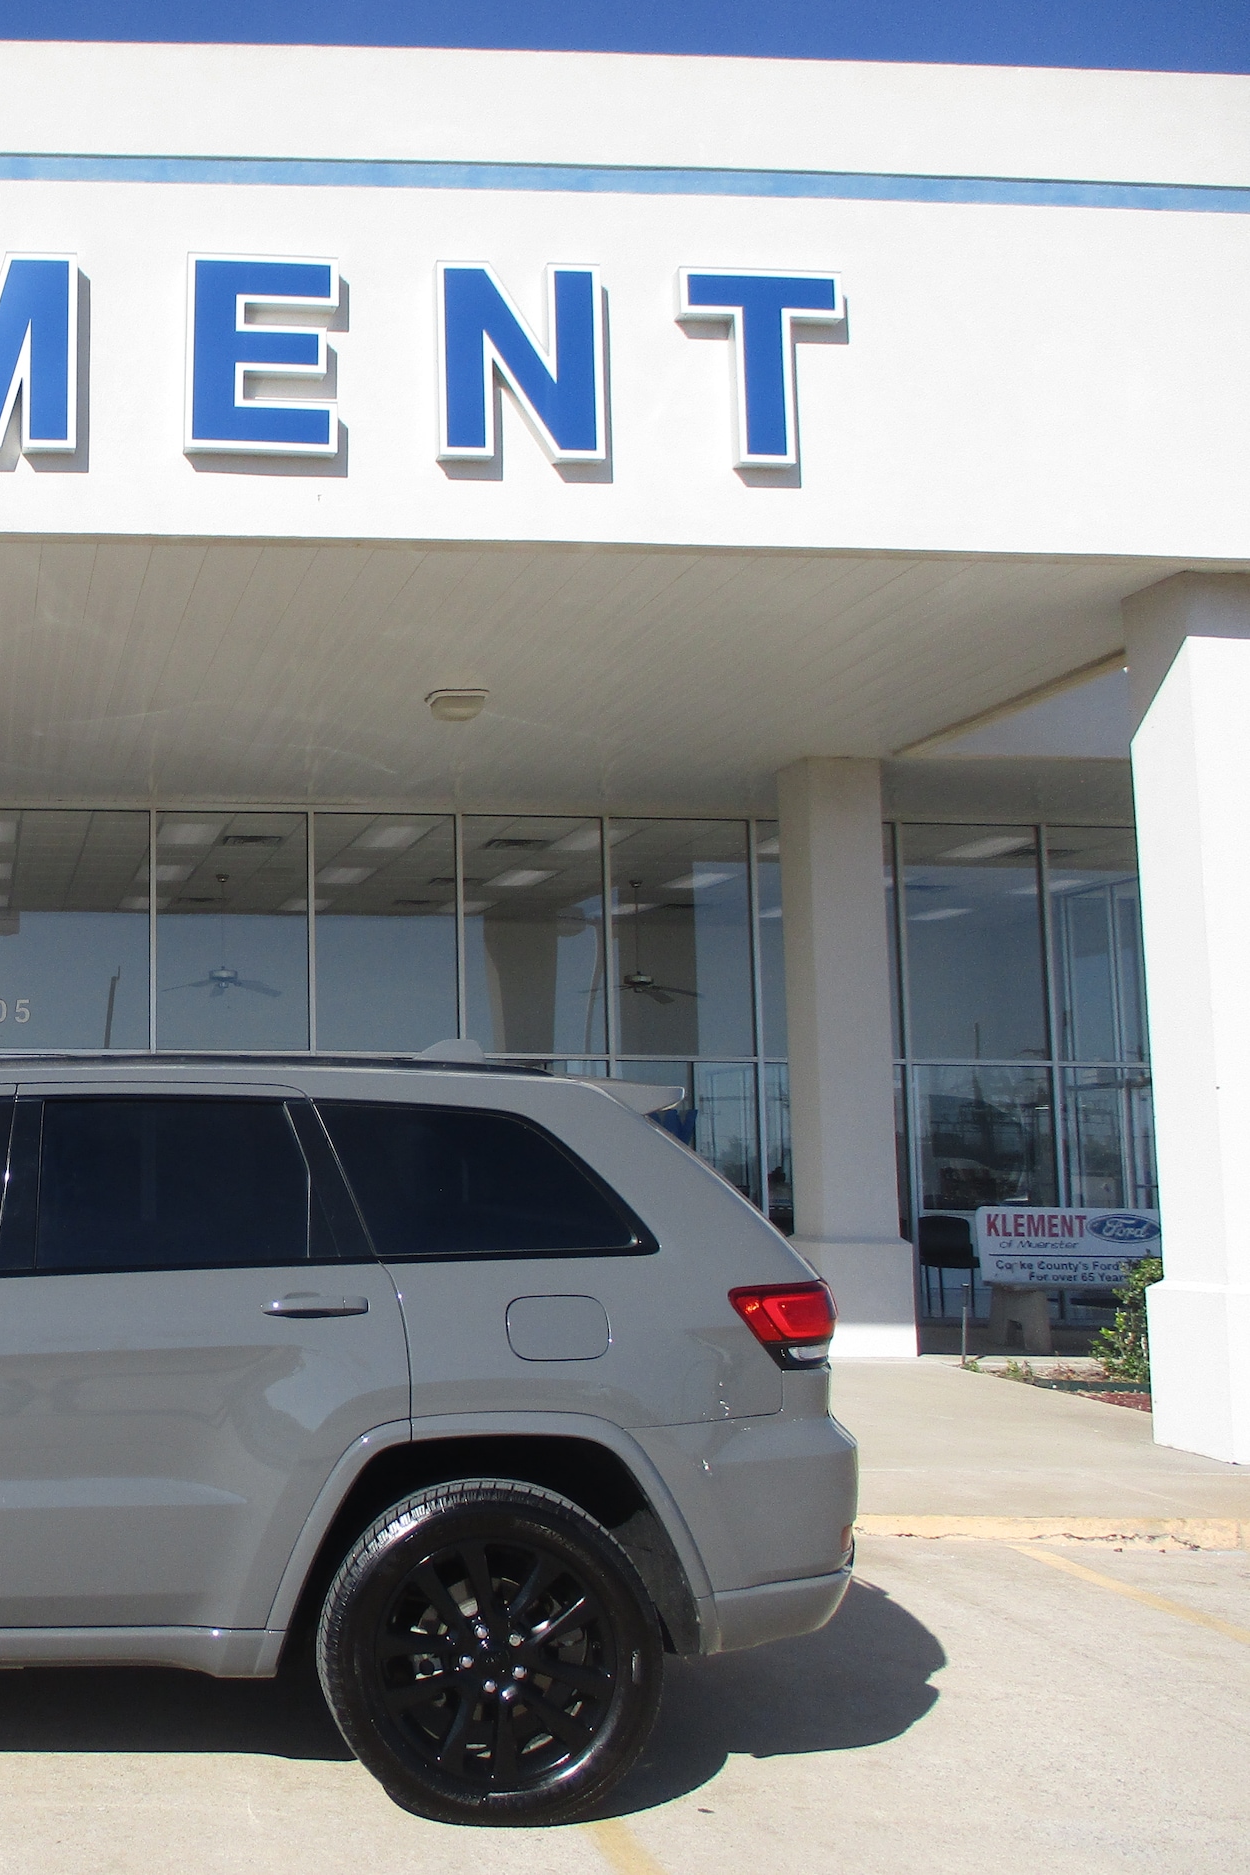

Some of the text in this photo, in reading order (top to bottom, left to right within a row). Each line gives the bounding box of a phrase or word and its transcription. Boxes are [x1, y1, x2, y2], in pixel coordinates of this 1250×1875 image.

[986, 1213, 1088, 1238] KLEMENT
[1103, 1217, 1151, 1238] Ford
[999, 1239, 1080, 1249] of Muenster
[995, 1259, 1034, 1271] Coke
[1037, 1260, 1089, 1272] County's
[1092, 1260, 1119, 1271] Ford
[1028, 1271, 1048, 1281] For
[1052, 1273, 1077, 1282] over
[1081, 1272, 1095, 1282] 65
